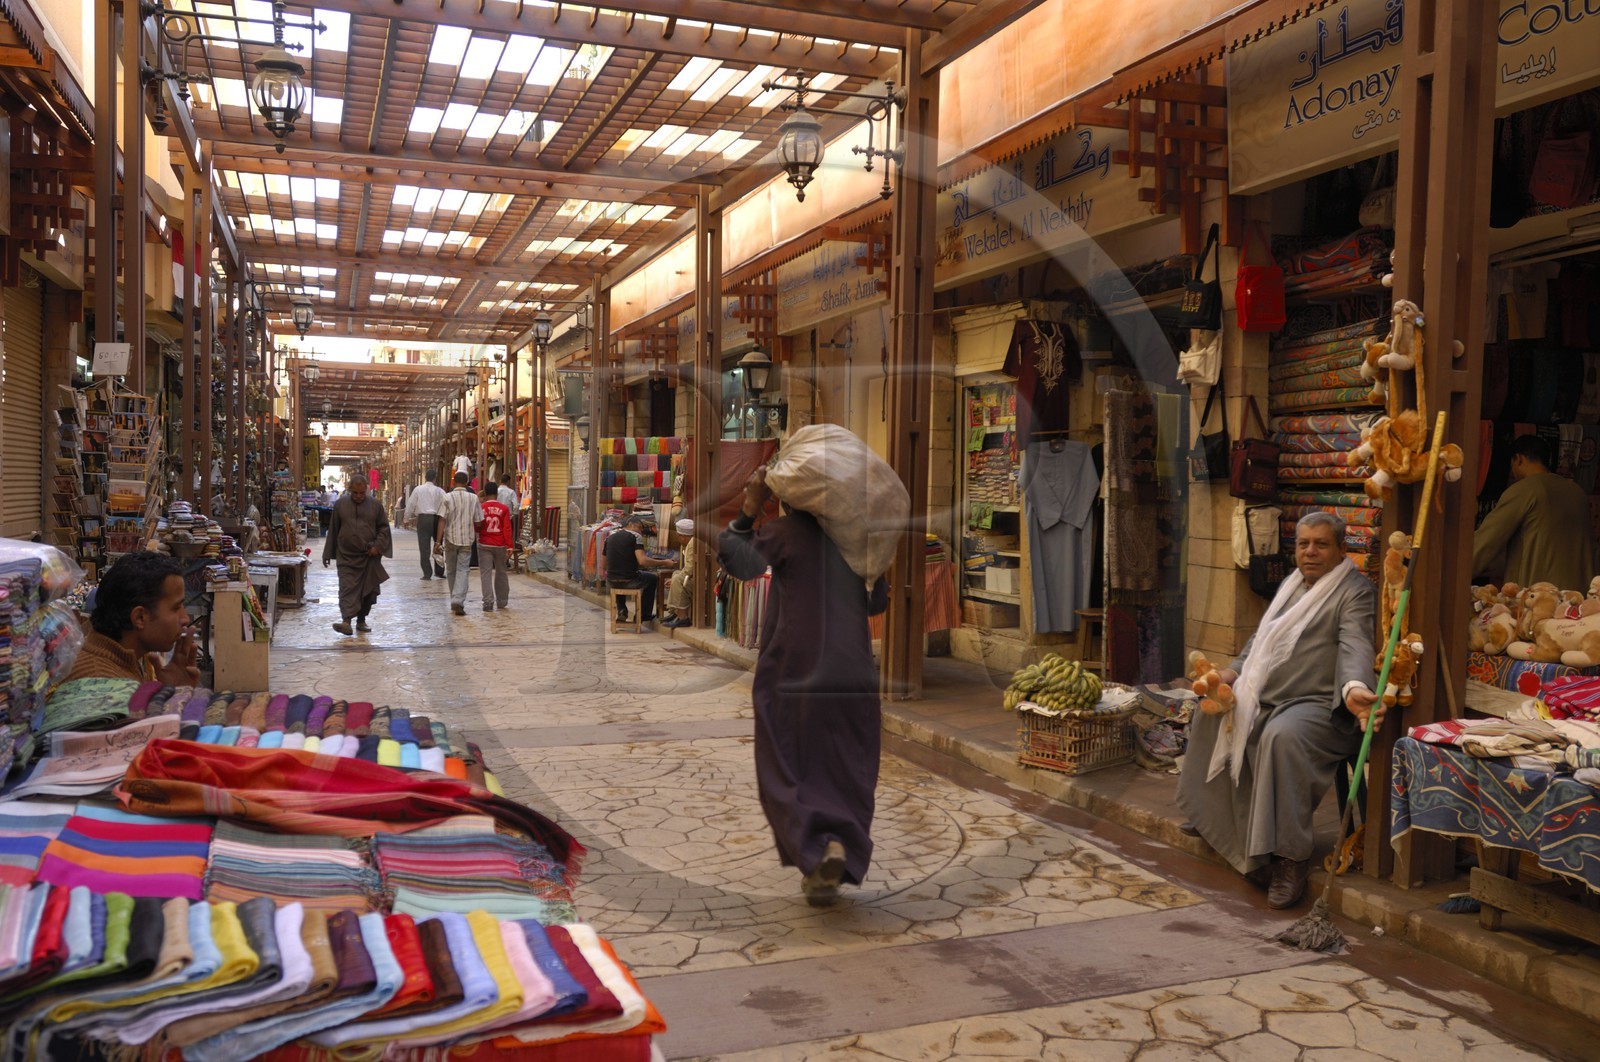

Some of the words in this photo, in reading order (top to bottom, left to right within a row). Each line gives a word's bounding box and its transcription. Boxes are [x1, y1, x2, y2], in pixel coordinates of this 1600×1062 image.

[1284, 64, 1400, 129] Adonay
[964, 223, 1016, 260] Wekalet
[1021, 212, 1033, 241] Al
[1039, 192, 1094, 234] Nekhily
[821, 282, 851, 312] Shafik
[486, 516, 501, 533] 22
